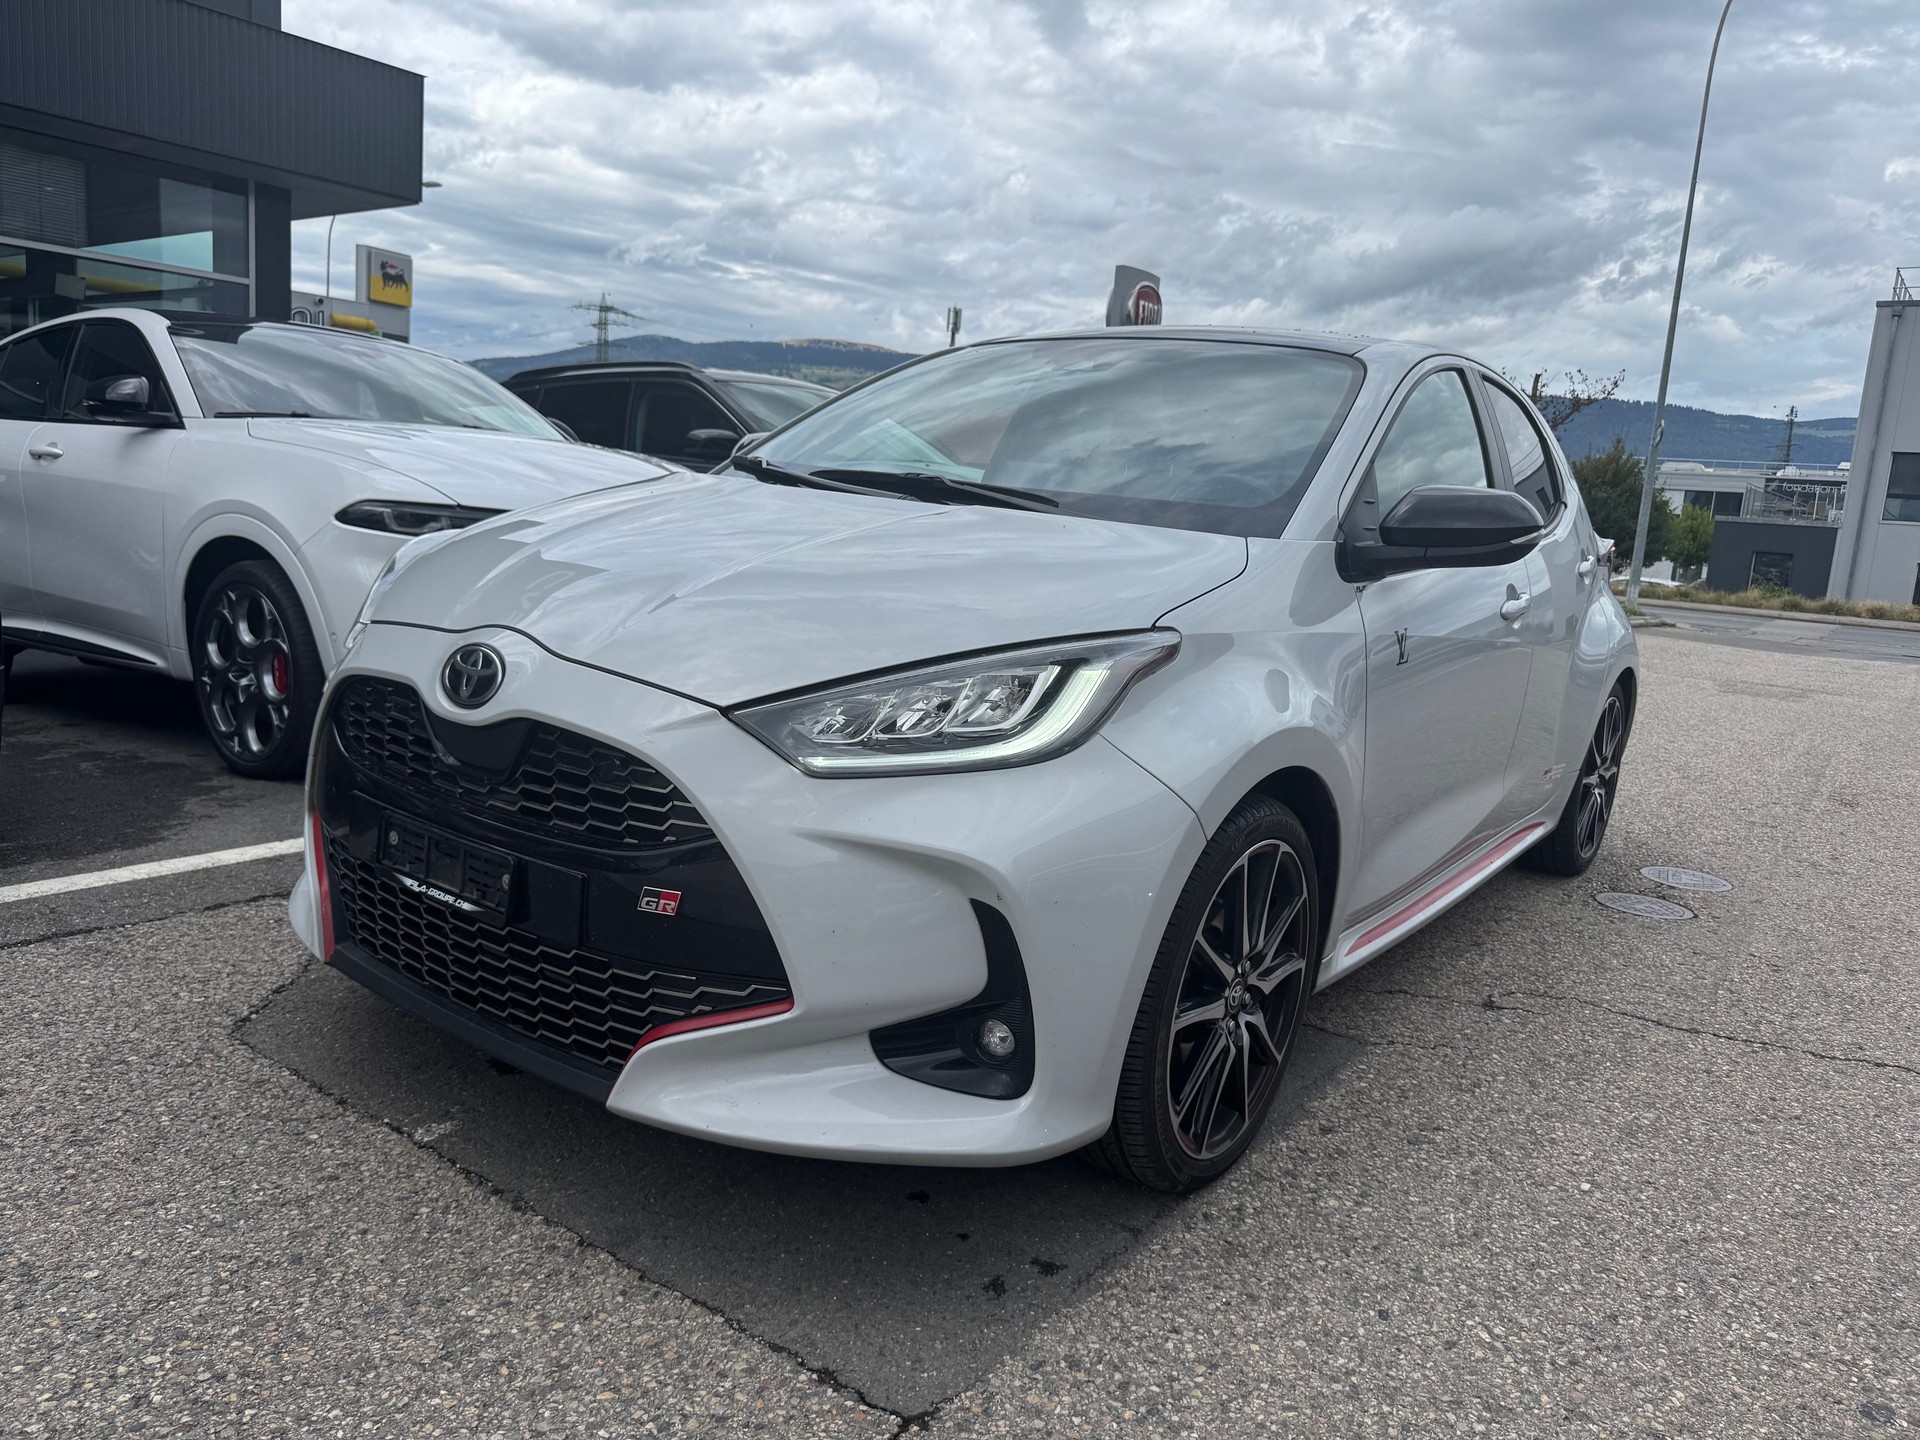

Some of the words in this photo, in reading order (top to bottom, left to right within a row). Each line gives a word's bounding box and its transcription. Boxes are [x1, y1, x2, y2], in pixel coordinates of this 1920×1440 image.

[1139, 299, 1159, 325] FIAT
[1783, 482, 1835, 494] fondation
[640, 897, 676, 913] GR
